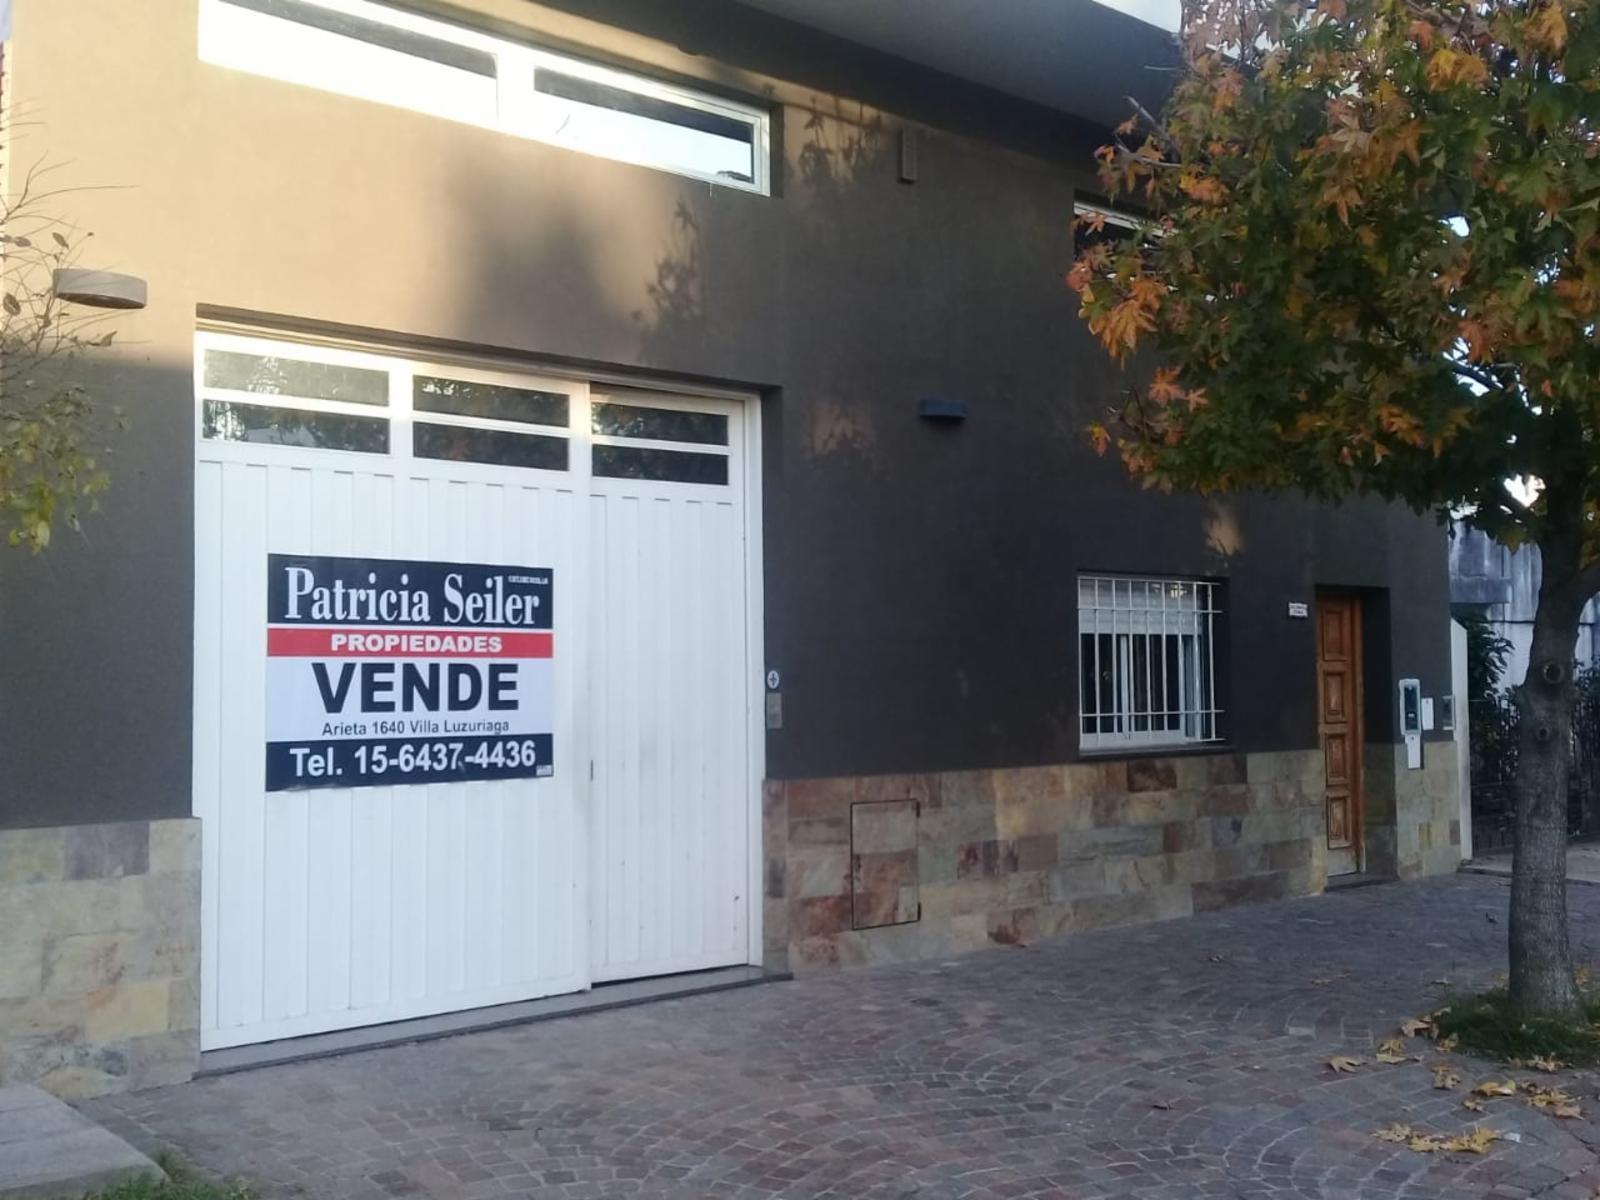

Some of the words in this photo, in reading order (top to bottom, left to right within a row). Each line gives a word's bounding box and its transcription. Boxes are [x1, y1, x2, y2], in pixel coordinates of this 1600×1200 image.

[284, 566, 430, 622] Patricia
[444, 573, 540, 624] Seiler
[331, 633, 503, 652] PROPIEDADES
[311, 662, 519, 713] VENDE
[322, 722, 367, 736] Arieta
[372, 720, 405, 735] 1640
[410, 720, 439, 734] Villa
[444, 719, 509, 735] Luzuriaga
[290, 747, 343, 777] Tel.
[354, 740, 536, 774] 15-6437-4436
